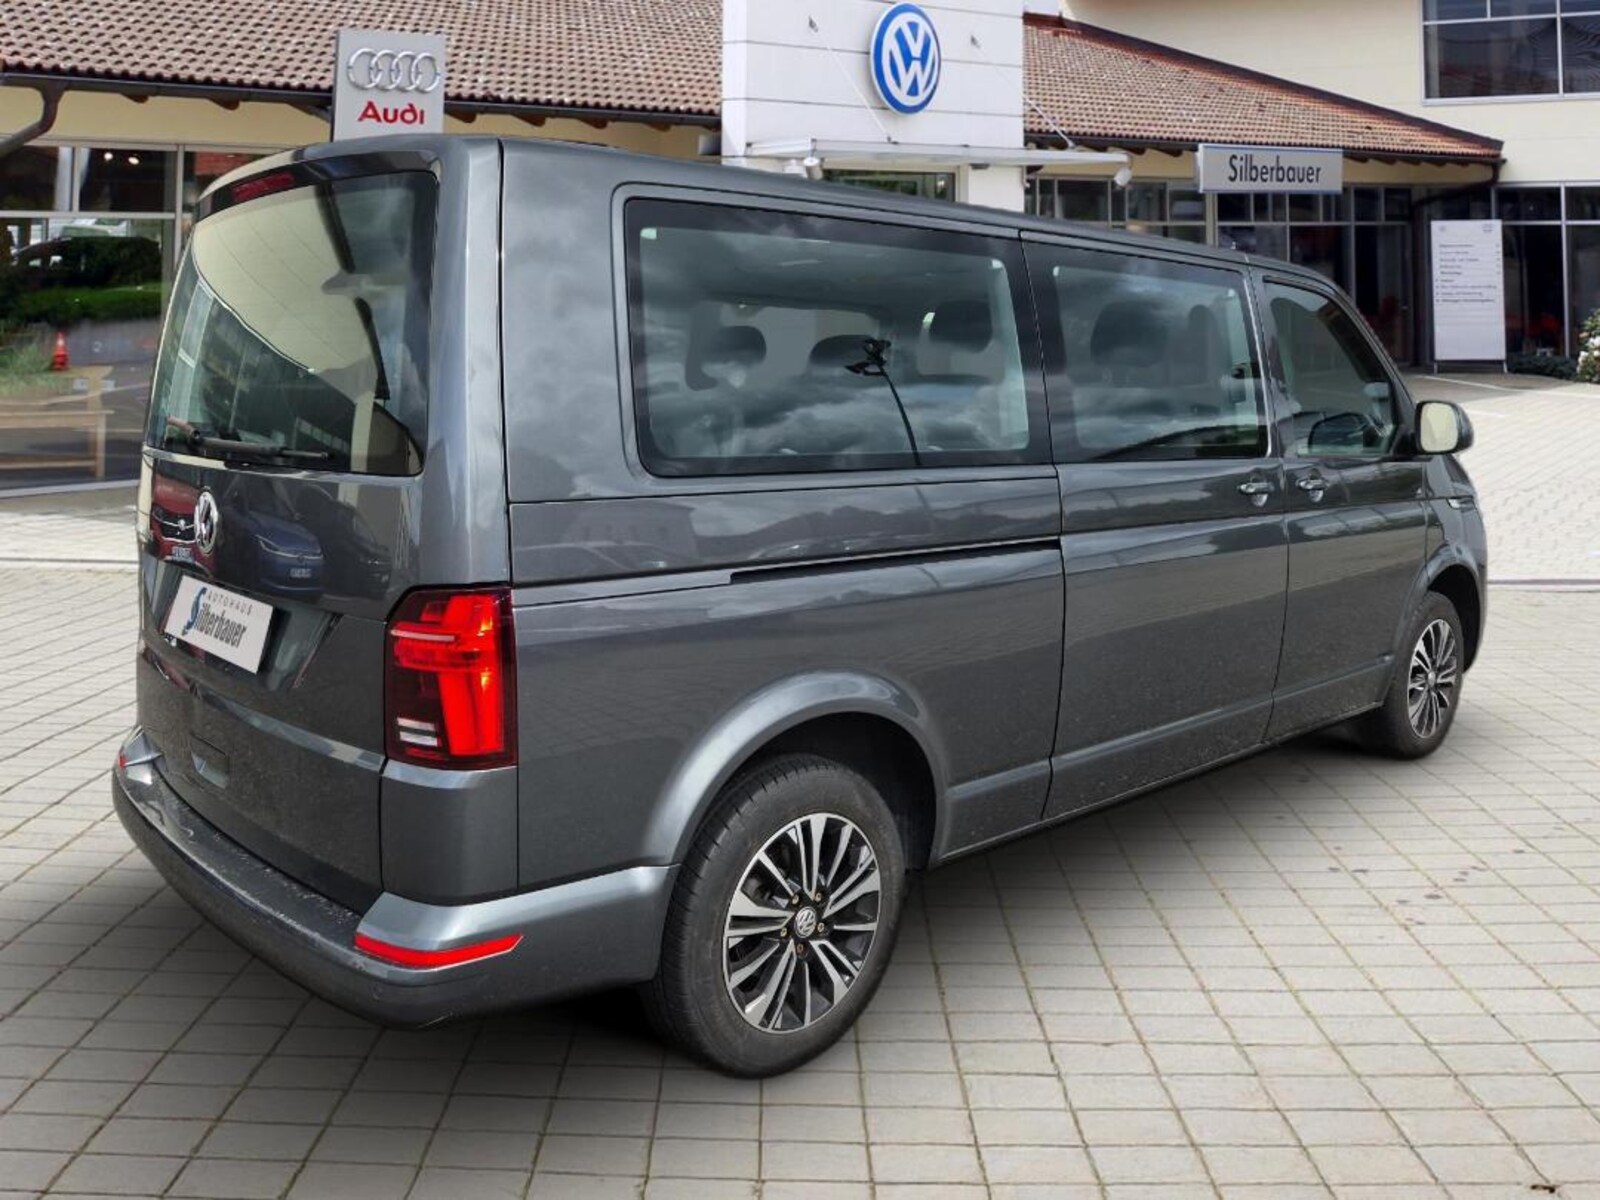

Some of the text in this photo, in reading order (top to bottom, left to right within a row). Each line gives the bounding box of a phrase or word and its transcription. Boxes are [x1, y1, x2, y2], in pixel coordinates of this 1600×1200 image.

[880, 9, 938, 107] VW
[357, 101, 425, 125] Audi
[1228, 154, 1322, 184] Silberbauer
[182, 587, 248, 648] Silberbauer
